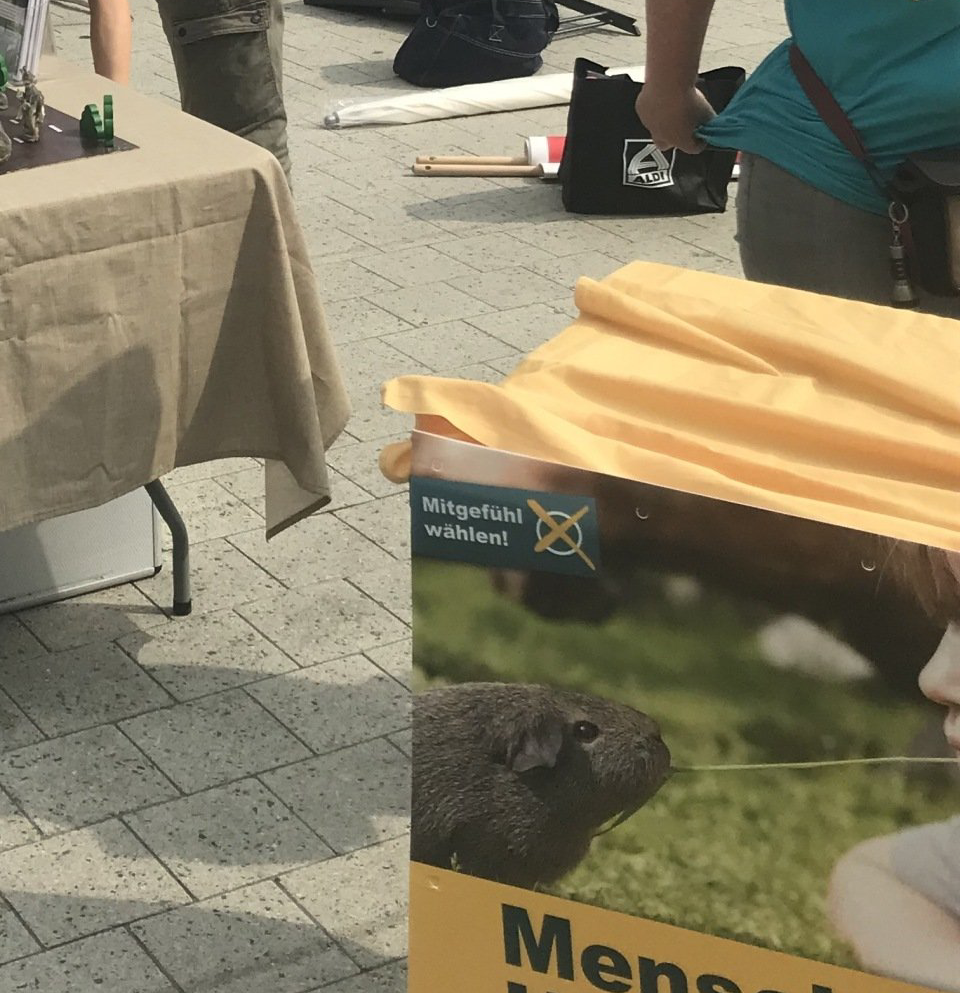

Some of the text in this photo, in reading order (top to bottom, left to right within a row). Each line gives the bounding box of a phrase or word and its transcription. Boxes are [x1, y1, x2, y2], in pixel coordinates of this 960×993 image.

[633, 171, 666, 184] ALDI
[421, 495, 524, 525] Mitgefühl
[423, 522, 510, 547] wählen!
